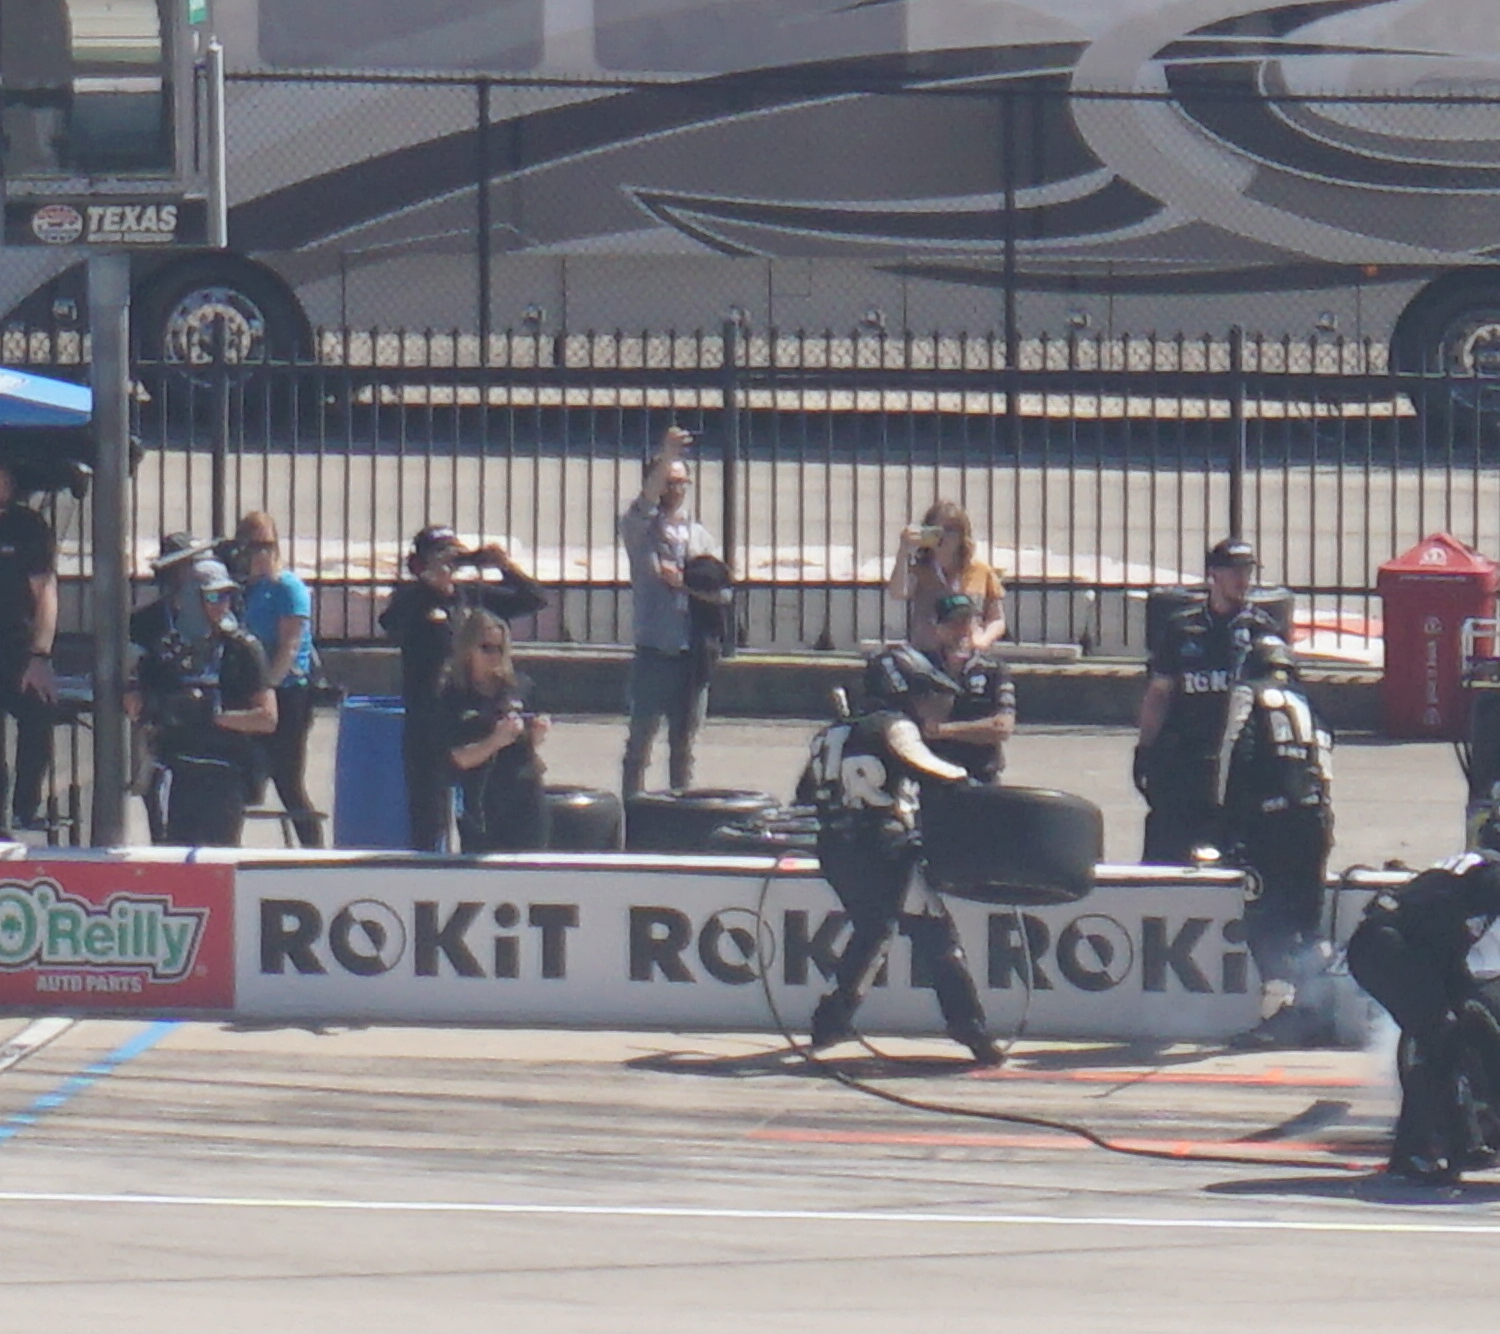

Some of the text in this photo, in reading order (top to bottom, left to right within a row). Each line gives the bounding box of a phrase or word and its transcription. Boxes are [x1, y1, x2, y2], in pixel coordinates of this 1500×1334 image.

[86, 205, 178, 232] TEXAS
[259, 898, 580, 979] ROKiT
[37, 974, 143, 993] AUTO PARTS
